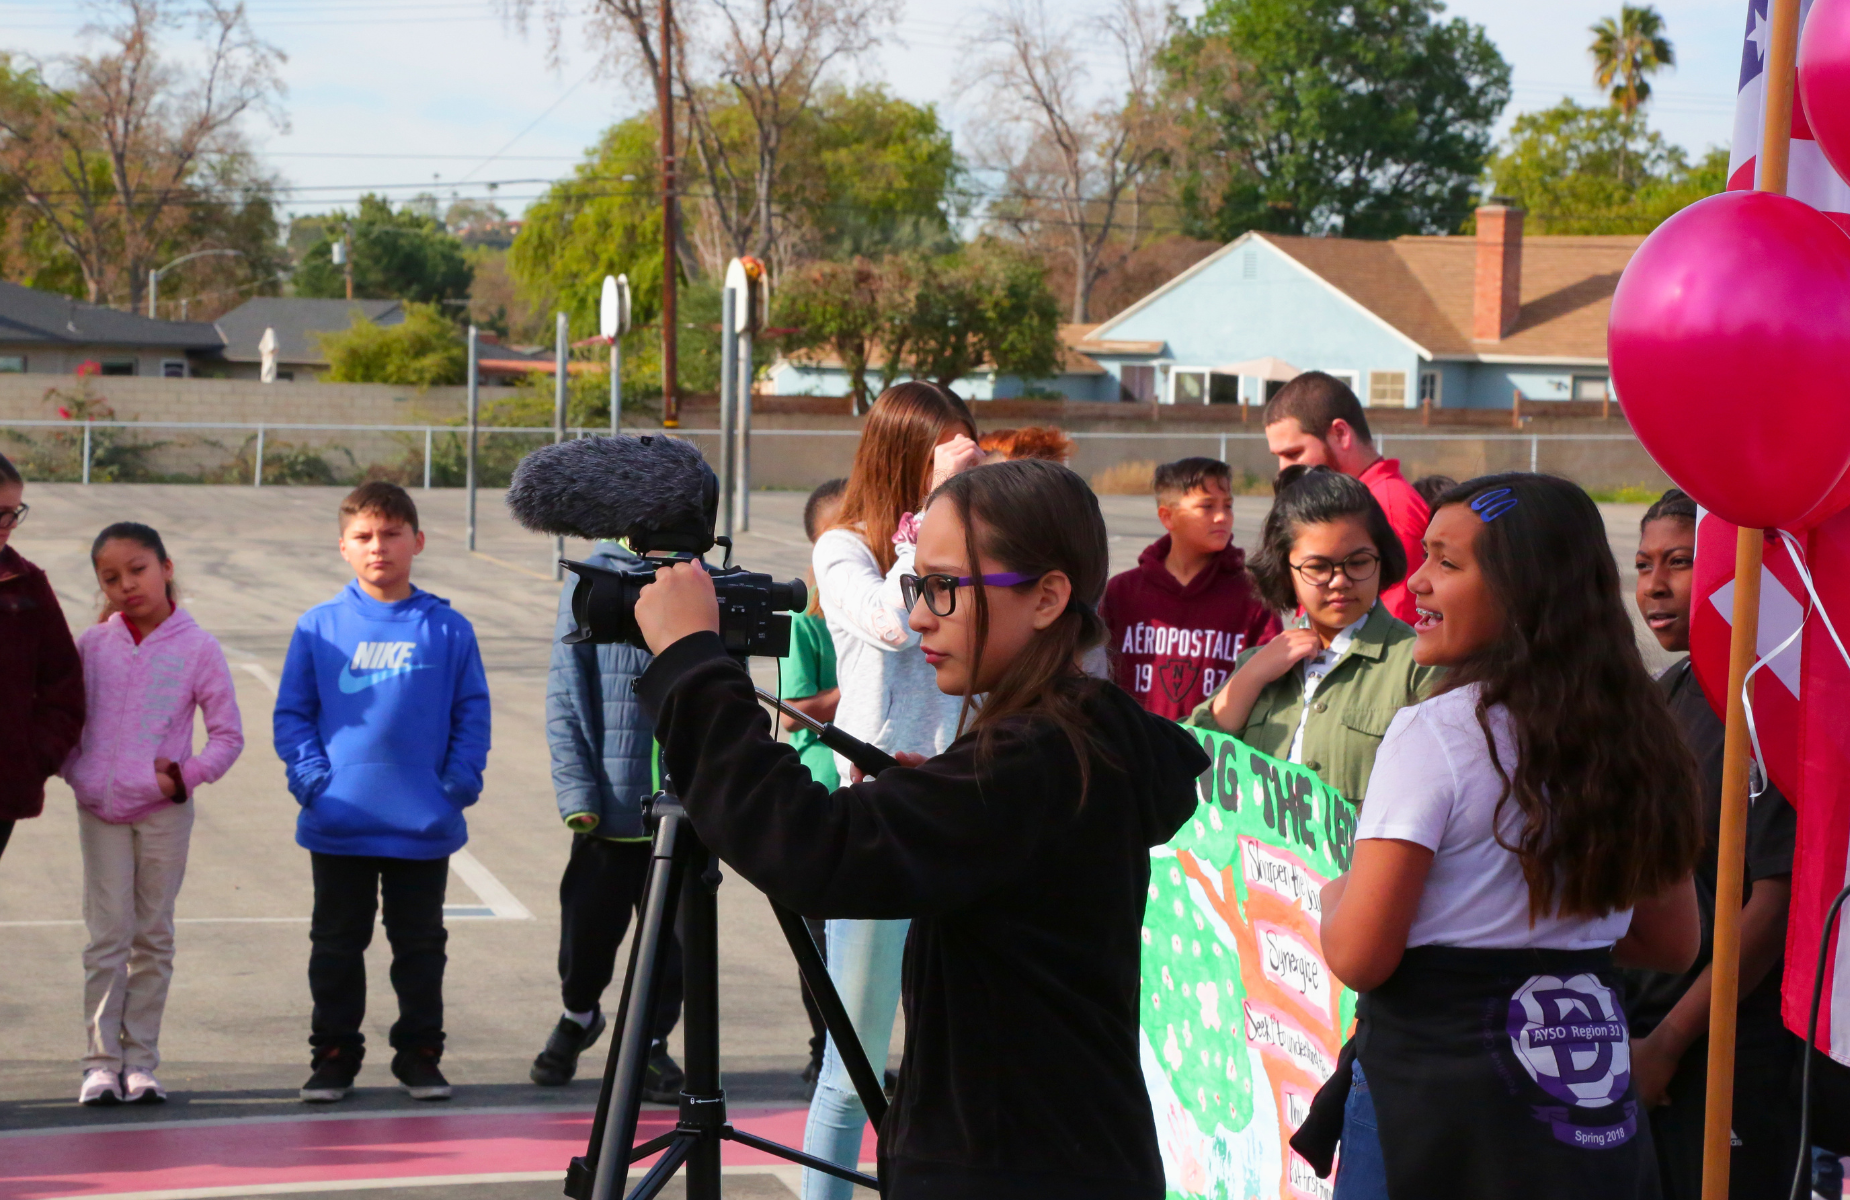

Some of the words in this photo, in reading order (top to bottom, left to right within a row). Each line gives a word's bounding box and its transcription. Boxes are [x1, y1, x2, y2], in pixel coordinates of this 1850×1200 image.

[350, 641, 417, 670] NIKE
[1121, 621, 1245, 662] AÉROPOSTALE
[1135, 663, 1153, 693] 19
[1203, 667, 1227, 697] 87
[1186, 728, 1238, 813] NG
[1250, 753, 1317, 851] THE
[1322, 786, 1357, 874] LEA
[1247, 840, 1290, 892] Sharpen
[1291, 863, 1305, 898] the
[1266, 929, 1318, 995] Synergize
[1244, 1001, 1271, 1041] Seek
[1277, 1019, 1287, 1047] to
[1533, 1026, 1566, 1042] AYSO
[1572, 1025, 1608, 1040] Region
[1609, 1025, 1621, 1037] 31
[1575, 1130, 1605, 1146] Spring
[1606, 1127, 1625, 1143] 2018
